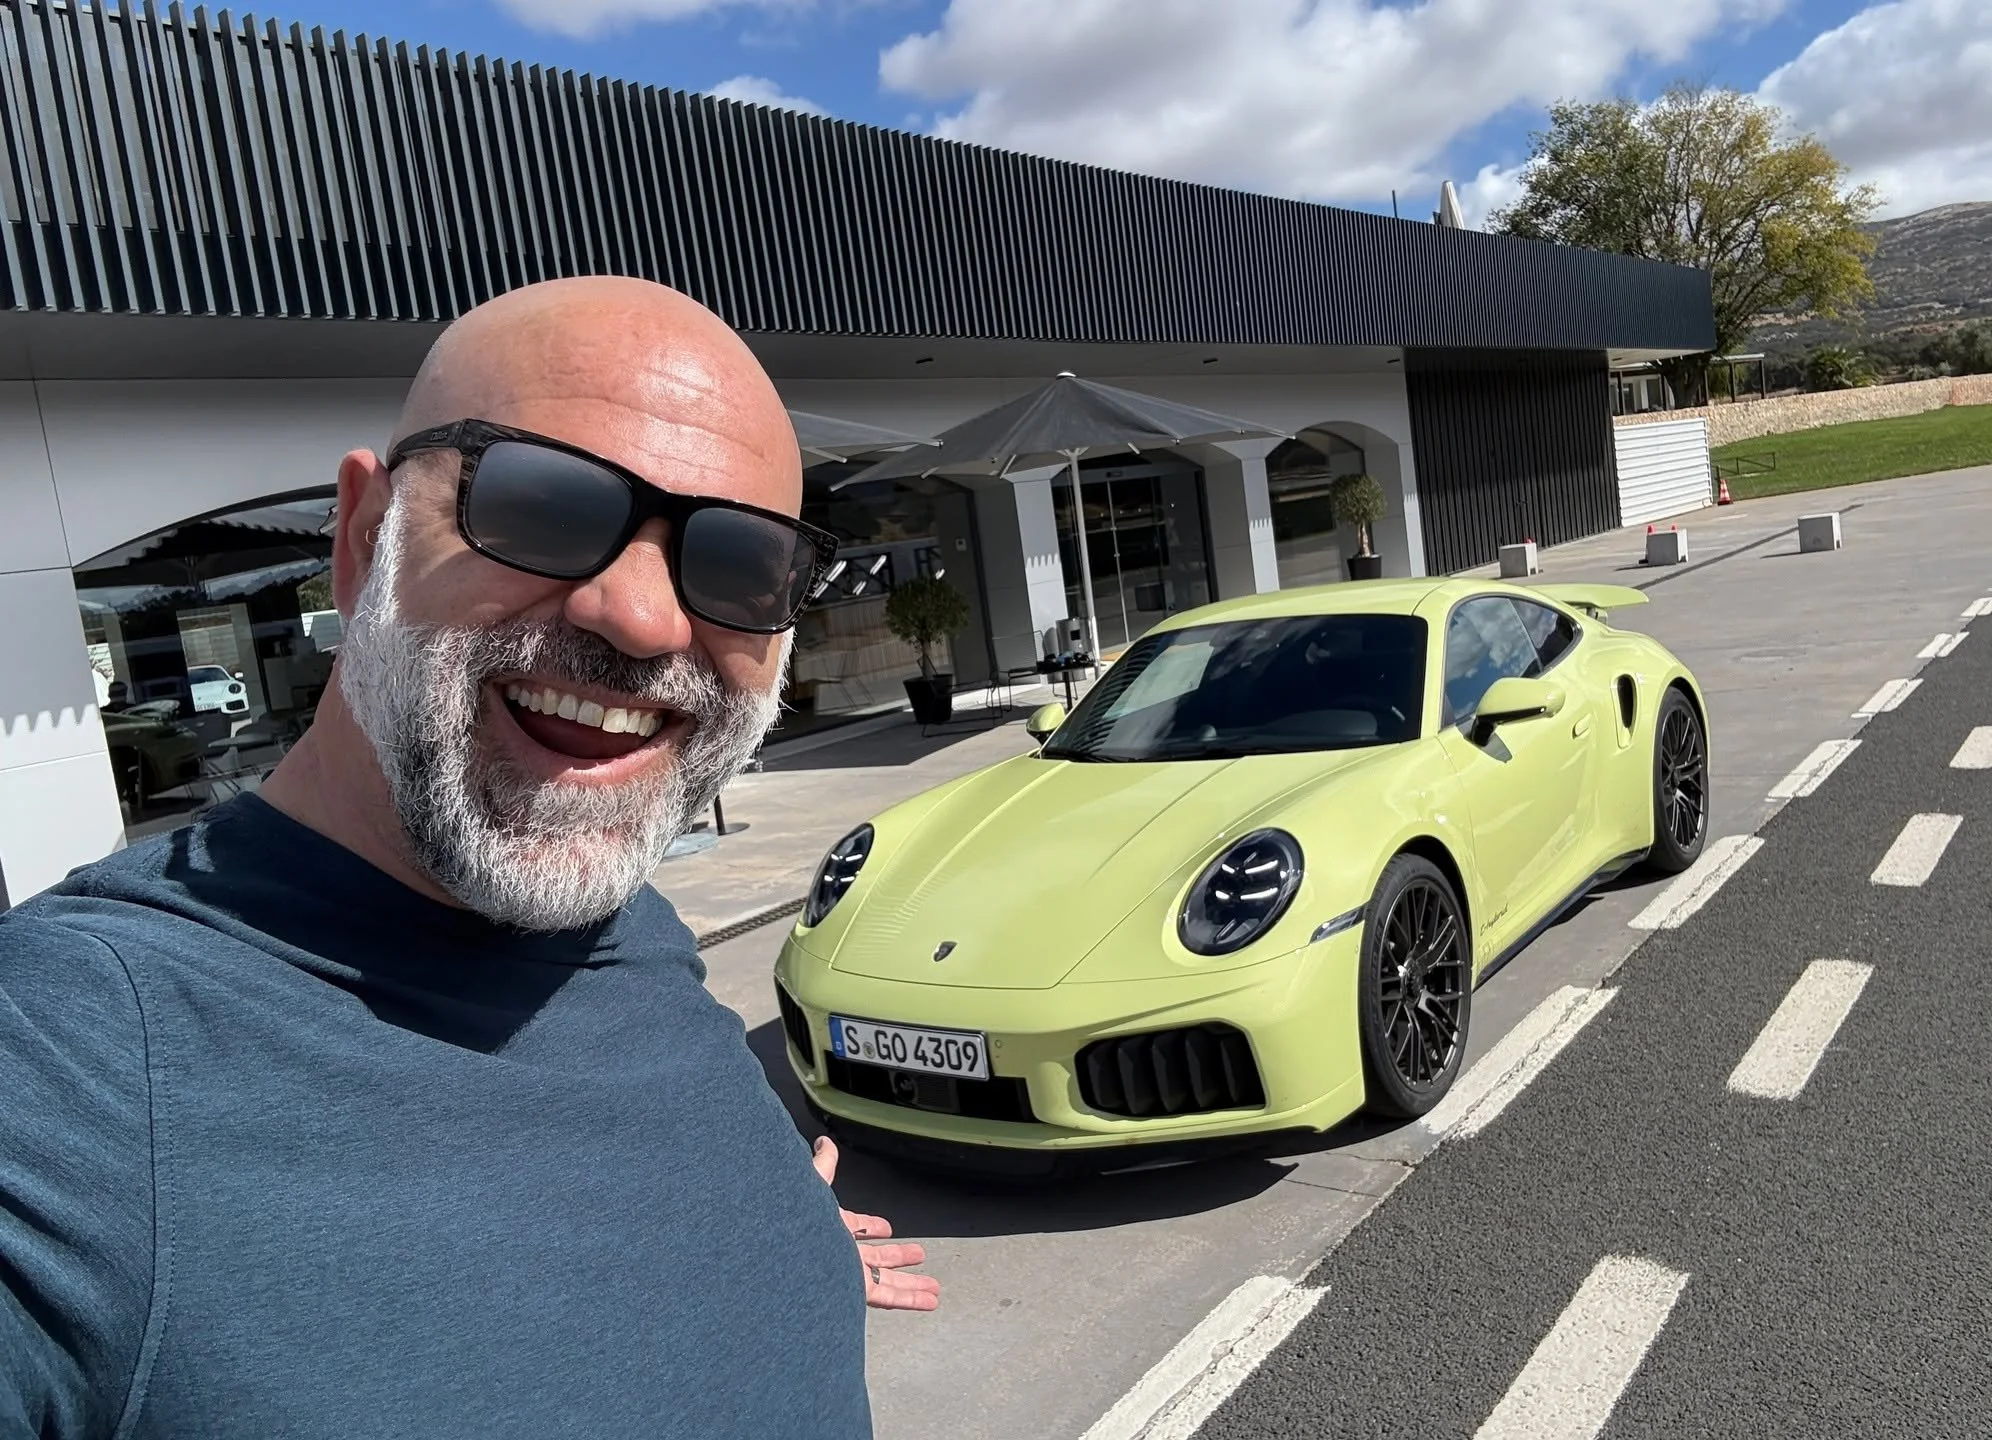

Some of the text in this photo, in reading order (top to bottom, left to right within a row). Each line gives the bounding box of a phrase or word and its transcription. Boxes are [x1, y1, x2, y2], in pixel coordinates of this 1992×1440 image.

[835, 1041, 842, 1050] D
[845, 1025, 978, 1072] S GO 4309
